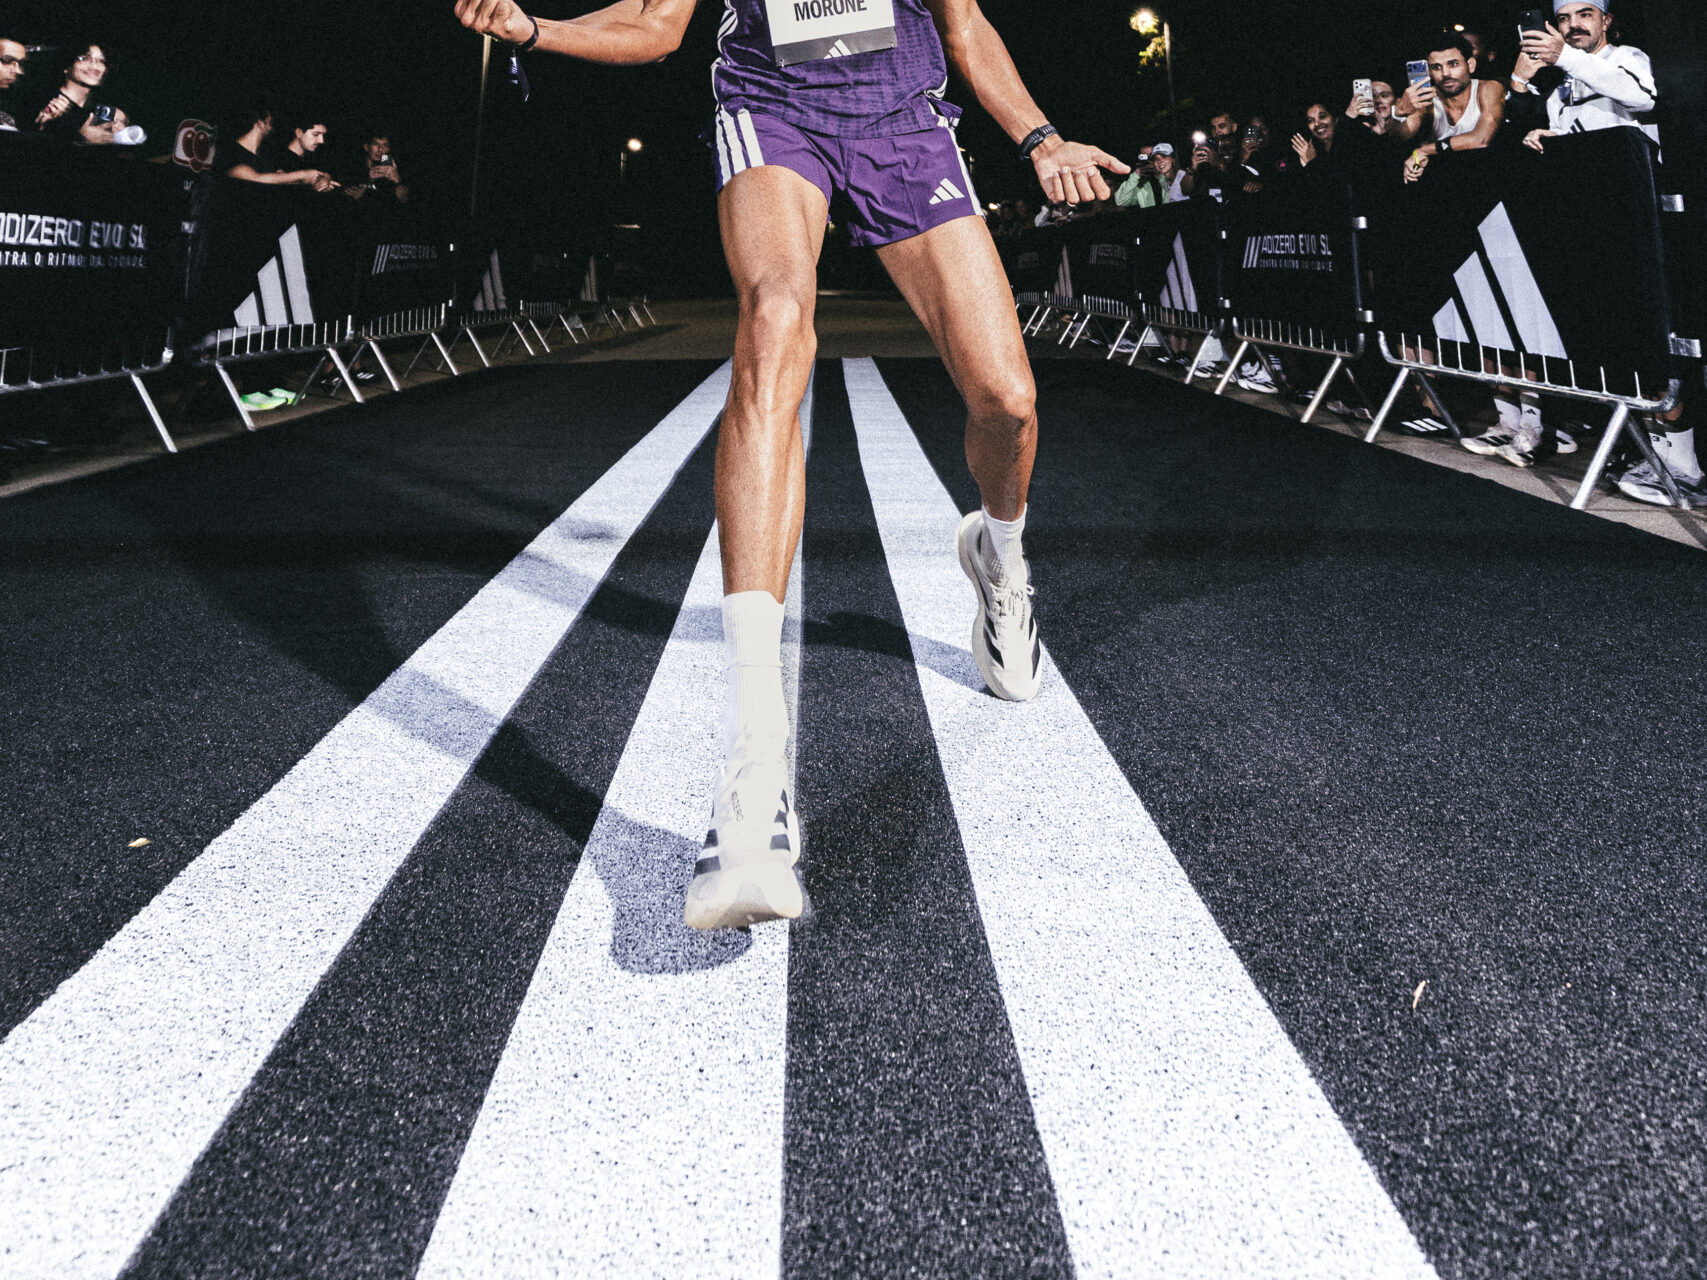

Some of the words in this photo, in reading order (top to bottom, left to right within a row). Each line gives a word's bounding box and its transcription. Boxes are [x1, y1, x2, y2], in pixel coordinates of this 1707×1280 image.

[0, 212, 82, 248] DIZERO
[90, 221, 123, 249] EVO
[129, 223, 145, 249] SL
[1261, 234, 1296, 254] ADIZERO
[1299, 233, 1317, 255] EVO
[1320, 234, 1332, 256] SL
[34, 251, 42, 266] O
[48, 252, 83, 267] RITMO
